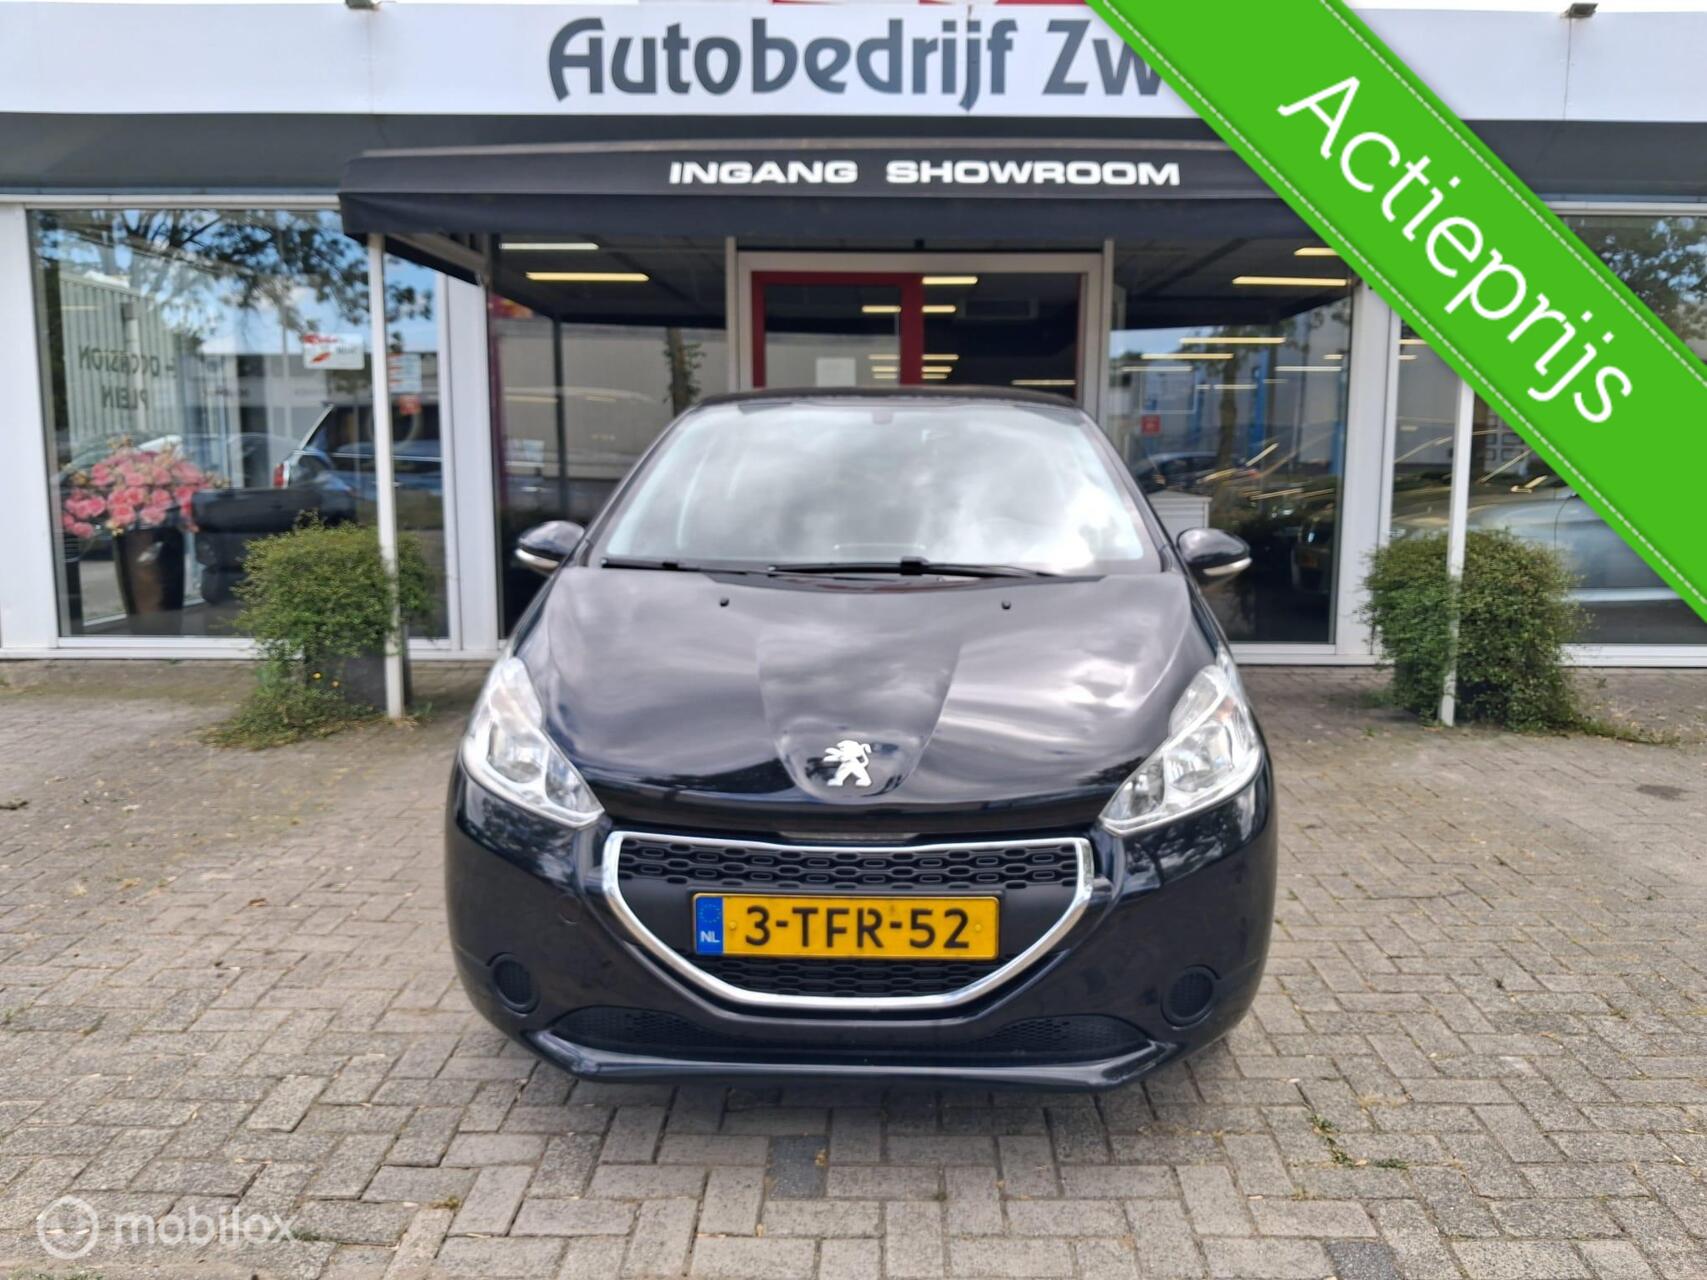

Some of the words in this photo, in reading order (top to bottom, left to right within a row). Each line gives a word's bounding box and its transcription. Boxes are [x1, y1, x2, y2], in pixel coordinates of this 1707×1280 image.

[548, 18, 1019, 112] Autobedrijf
[669, 161, 858, 185] INGANG
[886, 161, 1181, 187] SHOWROOM
[700, 930, 721, 943] NL
[745, 906, 970, 949] 3-TFR-52
